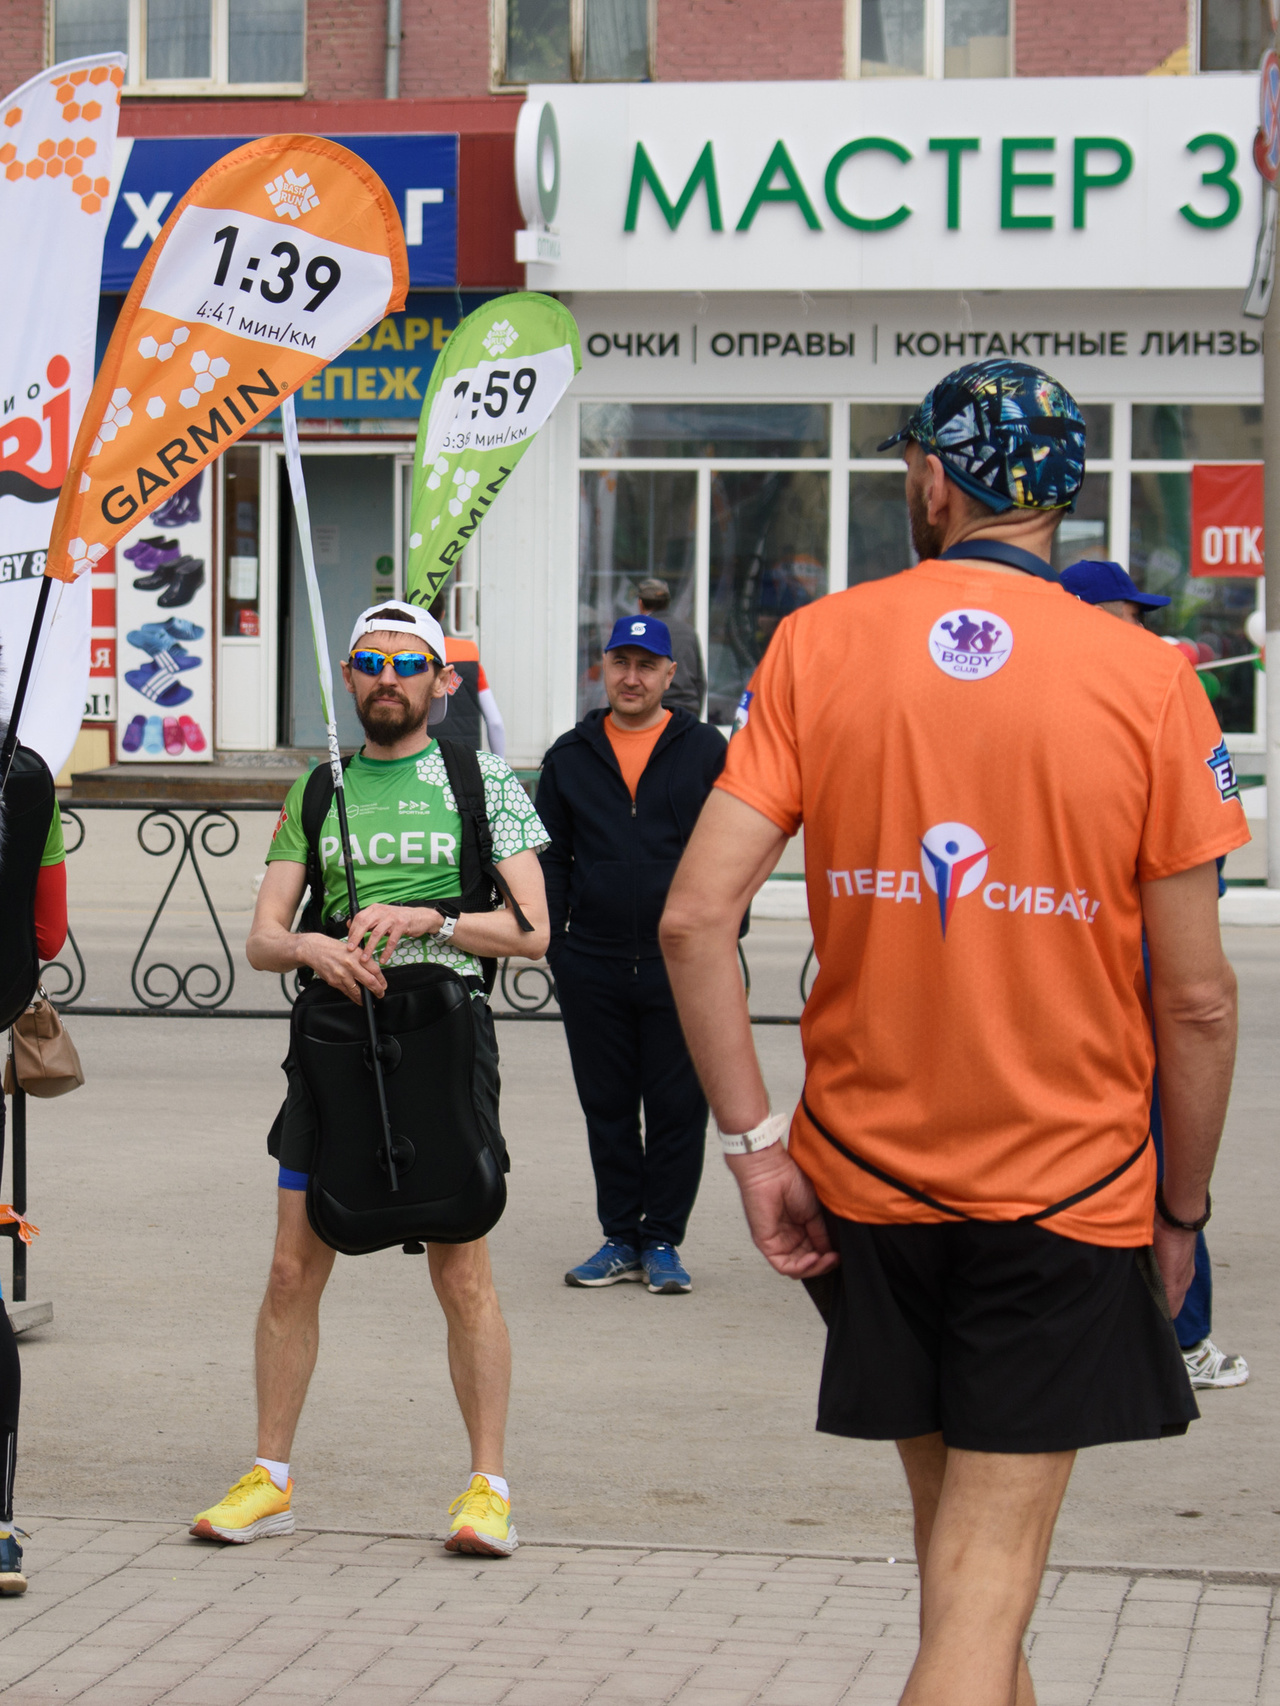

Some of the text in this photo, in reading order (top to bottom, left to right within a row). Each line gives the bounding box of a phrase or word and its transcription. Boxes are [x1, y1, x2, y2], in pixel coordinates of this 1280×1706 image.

[280, 191, 304, 206] RUN
[282, 181, 306, 197] BASH
[623, 136, 1134, 232] МАСТЕР
[213, 225, 342, 313] 1:39
[196, 300, 317, 349] 4:41 мин/км
[586, 330, 1265, 358] ОЧКИ ОПРАВЫ КОНТАКТНЫЕ ЛИНЗЫ
[454, 367, 537, 420] 1:59
[101, 368, 280, 525] GARMIN
[475, 425, 528, 446] мин/км
[408, 466, 512, 606] GARMIN
[1201, 526, 1264, 565] ОТК
[941, 650, 994, 668] BODY
[952, 664, 979, 675] CLUB
[321, 831, 457, 870] PACER
